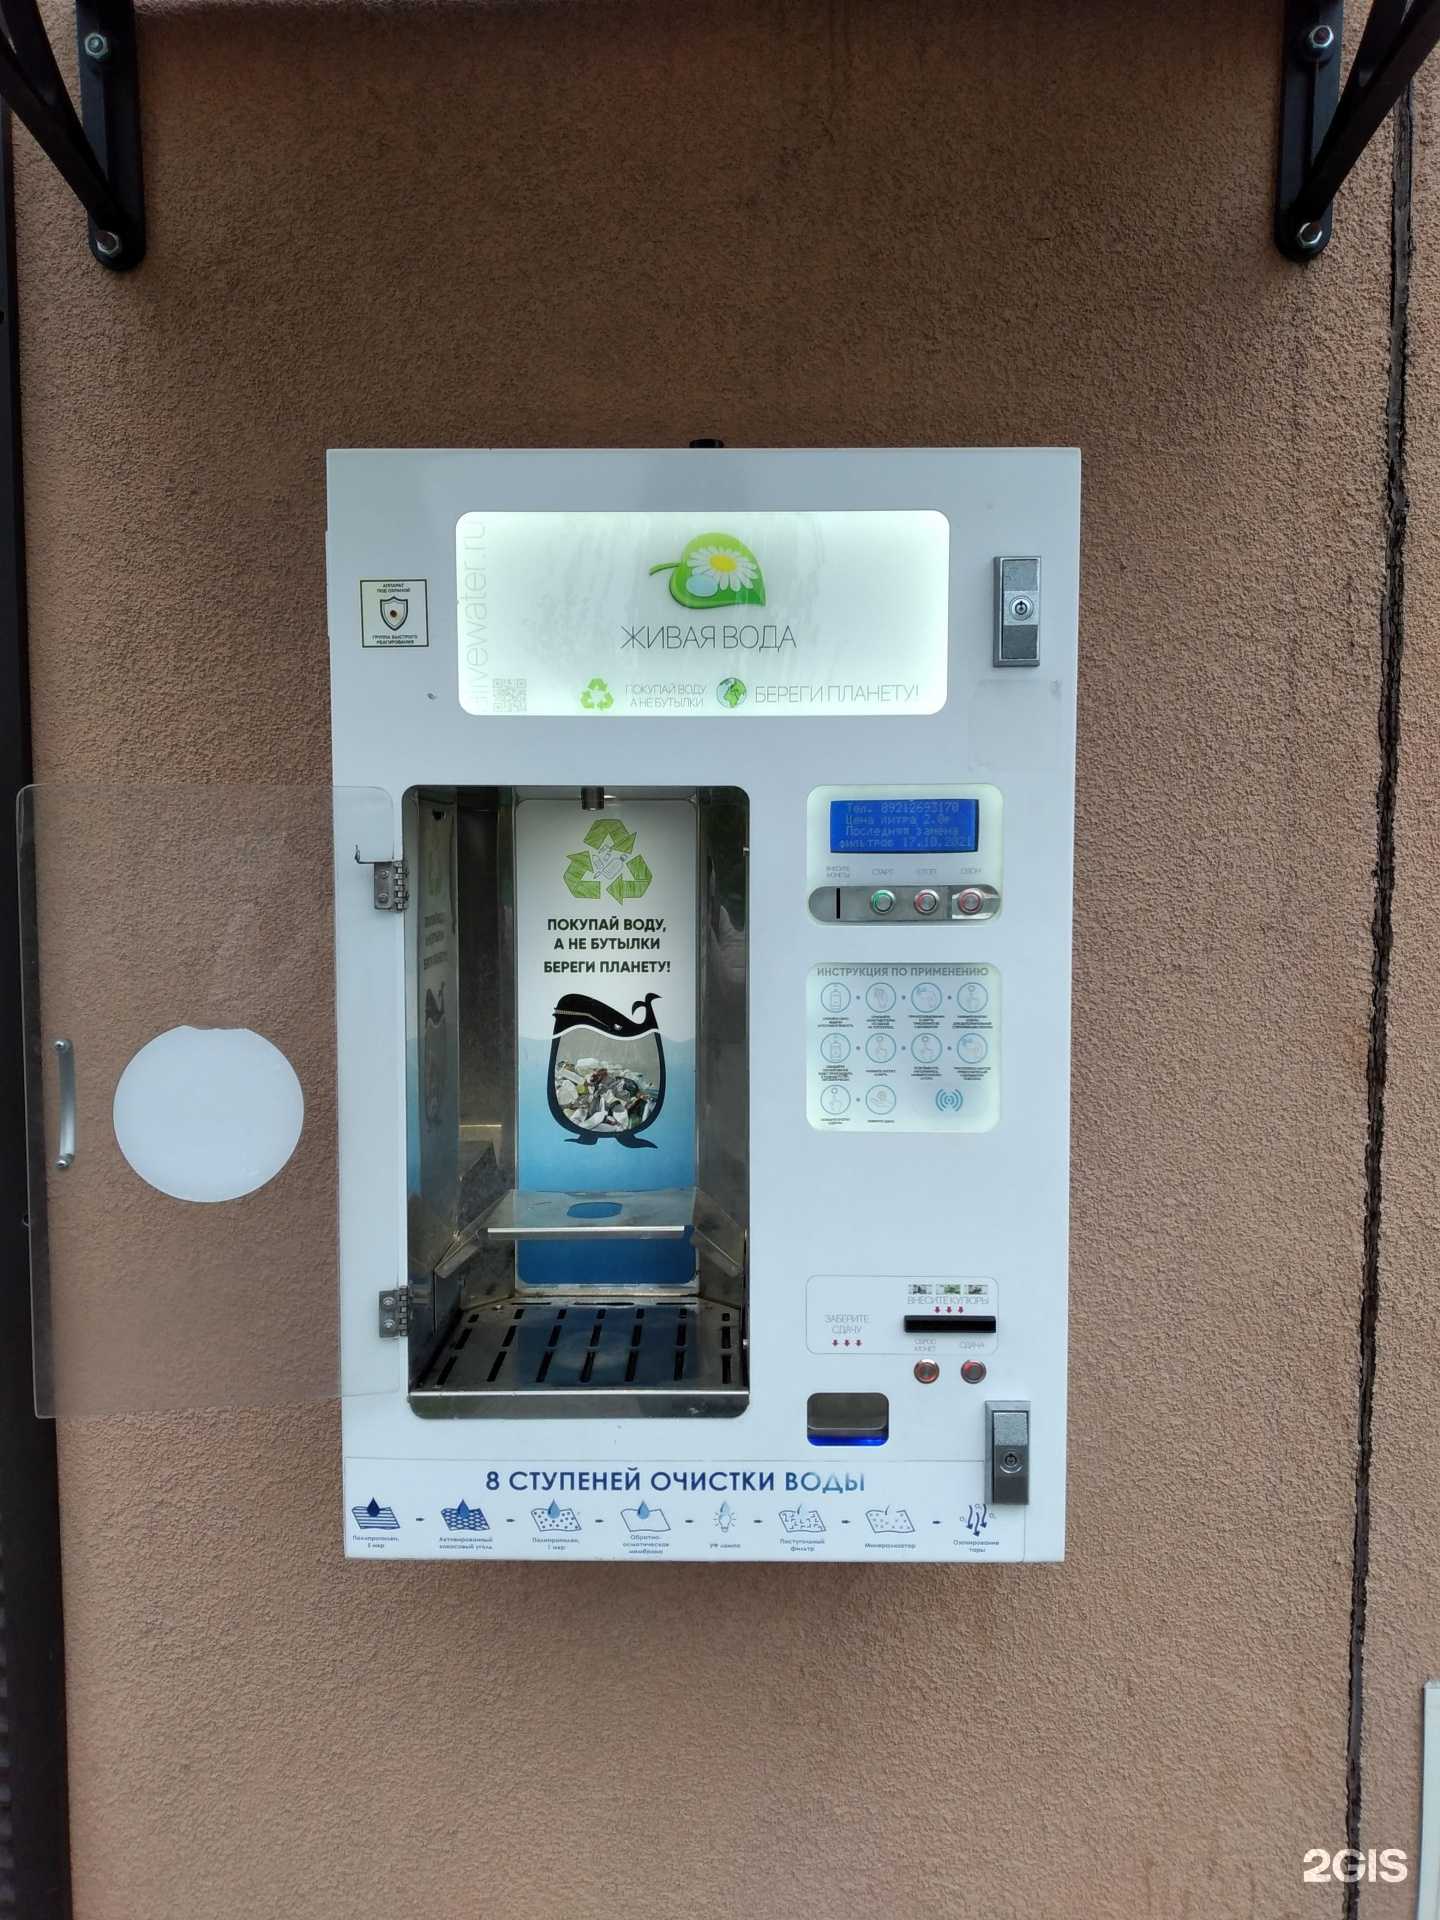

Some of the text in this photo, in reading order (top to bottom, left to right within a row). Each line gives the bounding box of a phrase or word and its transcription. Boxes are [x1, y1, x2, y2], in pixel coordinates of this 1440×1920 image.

[620, 625, 797, 652] ЖИВАЯ ВОДА
[625, 682, 707, 696] ПОКУПАЙ ВОДУ
[755, 684, 919, 704] БЕРЕГИ ПЛАНЕТУ!
[631, 697, 704, 708] А НЕ БУТЫЛКИ
[547, 915, 667, 934] ПОКУПАЙ ВОДУ,
[554, 938, 660, 950] А НЕ БУТЫЛКИ
[544, 960, 671, 974] БЕРЕГИ ПЛАНЕТУ!
[817, 968, 989, 978] ИНСТРУКЦИЯ ПО ПРИМЕНЕНИЮ
[907, 1296, 989, 1305] ВНЕСИТЕ КУПЮРЫ
[824, 1314, 870, 1324] ЗАБЕРИТЕ
[832, 1325, 862, 1334] СДАЧУ
[486, 1467, 865, 1494] 8 СТУПЕНЕЙ ОЧИСТКИ ВОДЫ
